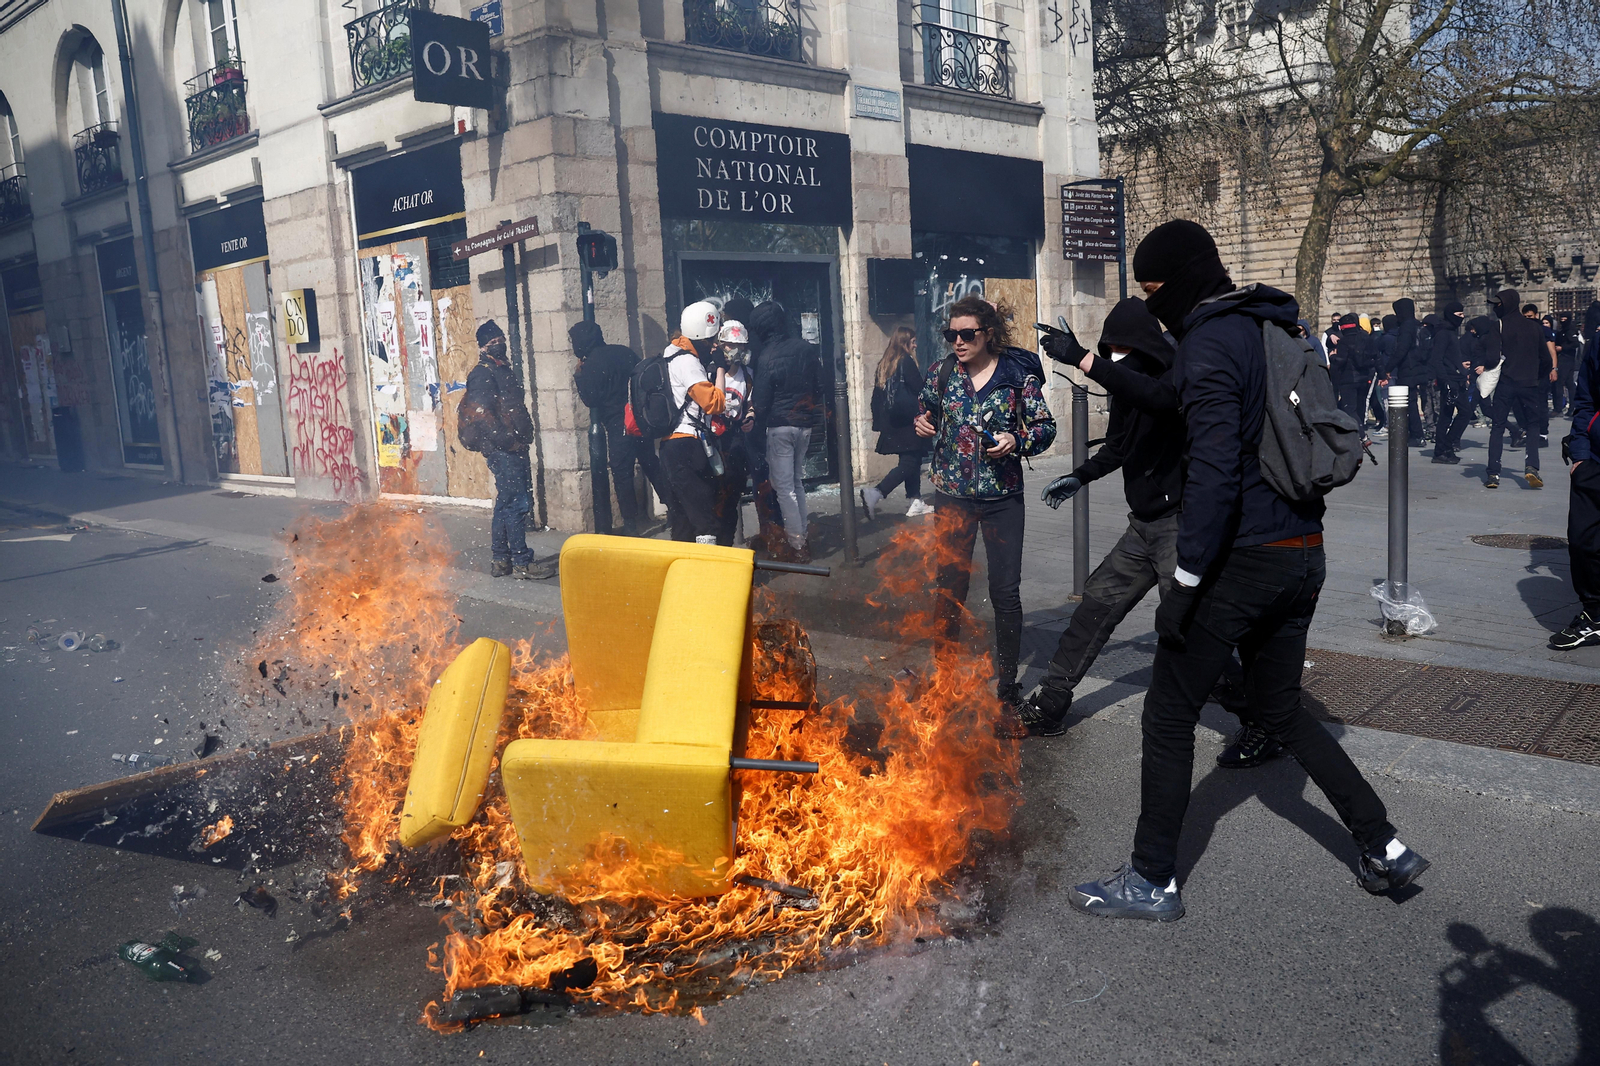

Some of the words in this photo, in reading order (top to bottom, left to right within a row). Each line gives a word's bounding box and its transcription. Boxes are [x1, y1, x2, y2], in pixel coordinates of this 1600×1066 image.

[422, 40, 484, 81] OR
[694, 125, 819, 158] COMPTOIR
[696, 157, 821, 187] NATIONAL
[391, 192, 420, 213] ACHAT
[420, 189, 434, 205] OR
[697, 188, 730, 211] DE
[740, 190, 794, 214] L'OR
[220, 238, 239, 254] VENTE
[239, 236, 248, 249] OR
[285, 297, 302, 317] CN
[288, 316, 305, 337] DO
